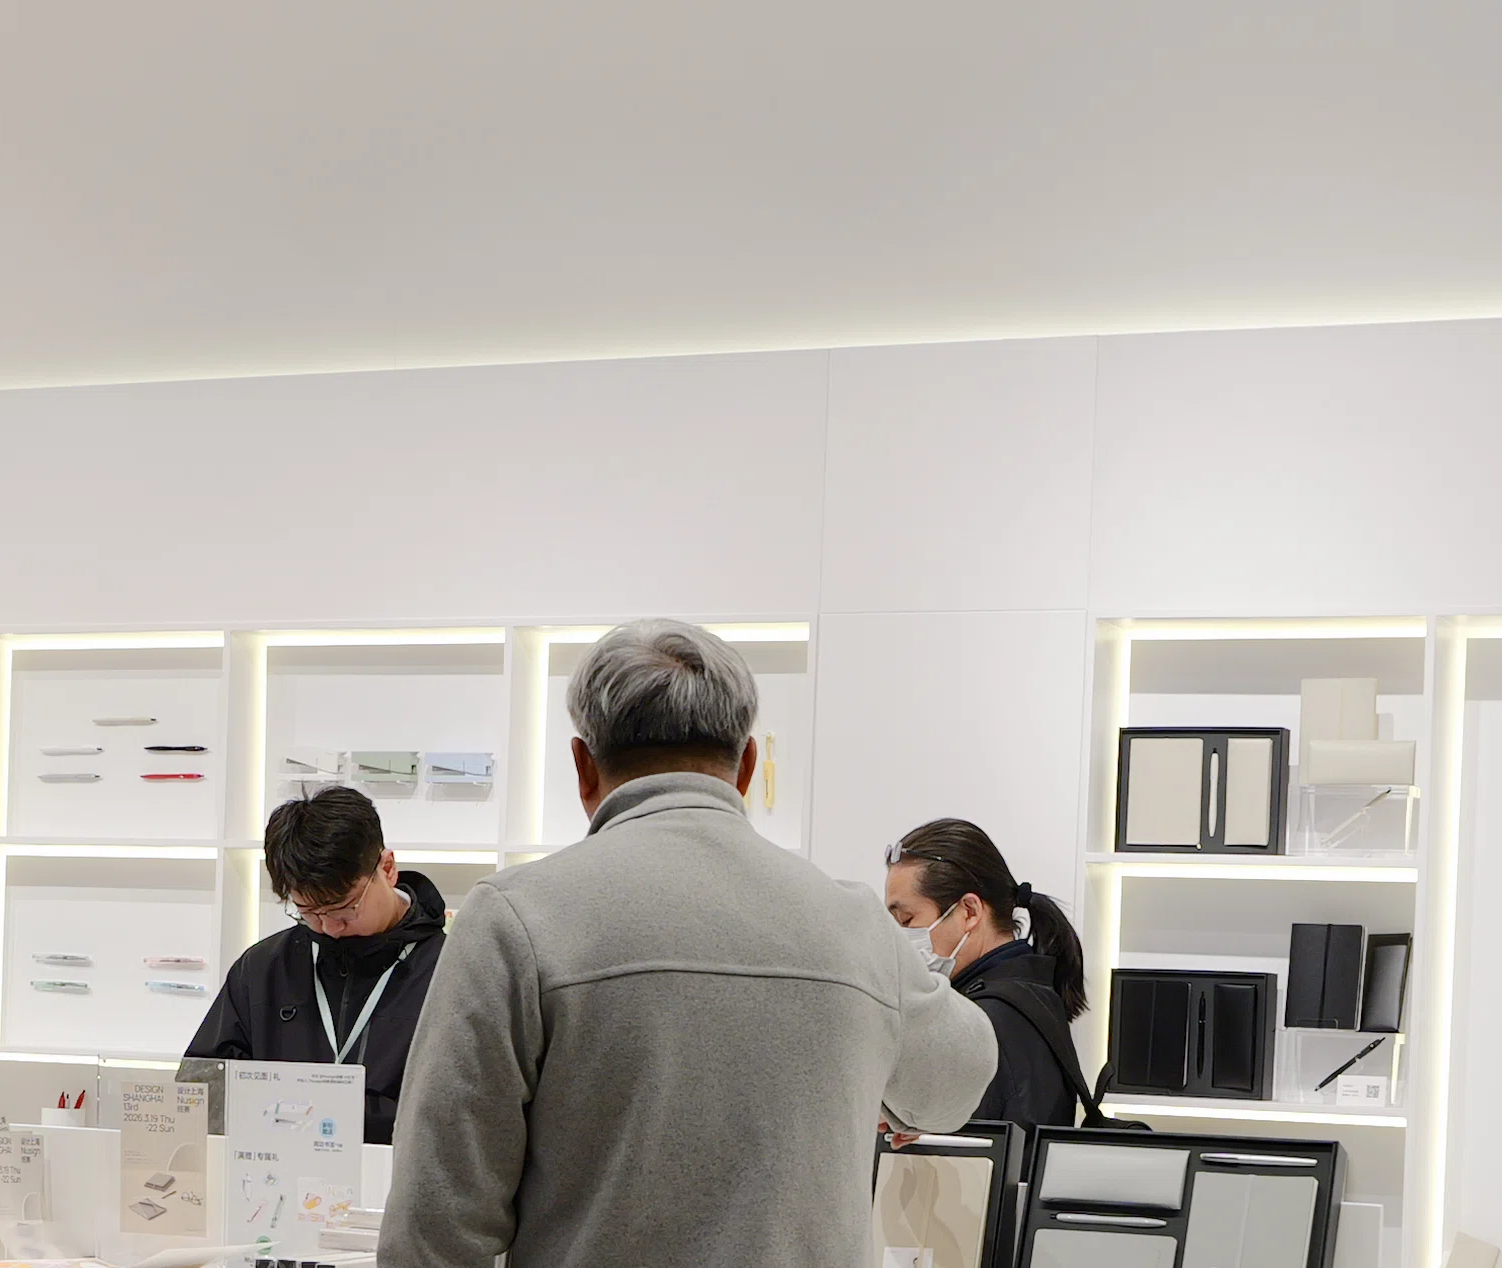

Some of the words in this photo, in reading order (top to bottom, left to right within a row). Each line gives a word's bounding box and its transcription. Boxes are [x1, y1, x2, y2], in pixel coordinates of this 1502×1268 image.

[135, 1084, 164, 1094] DESIGN
[123, 1093, 164, 1103] SHANGHAI
[177, 1096, 205, 1107] Nusign
[123, 1102, 139, 1111] 13rd
[160, 1114, 175, 1124] Thu
[159, 1124, 175, 1133] Sun
